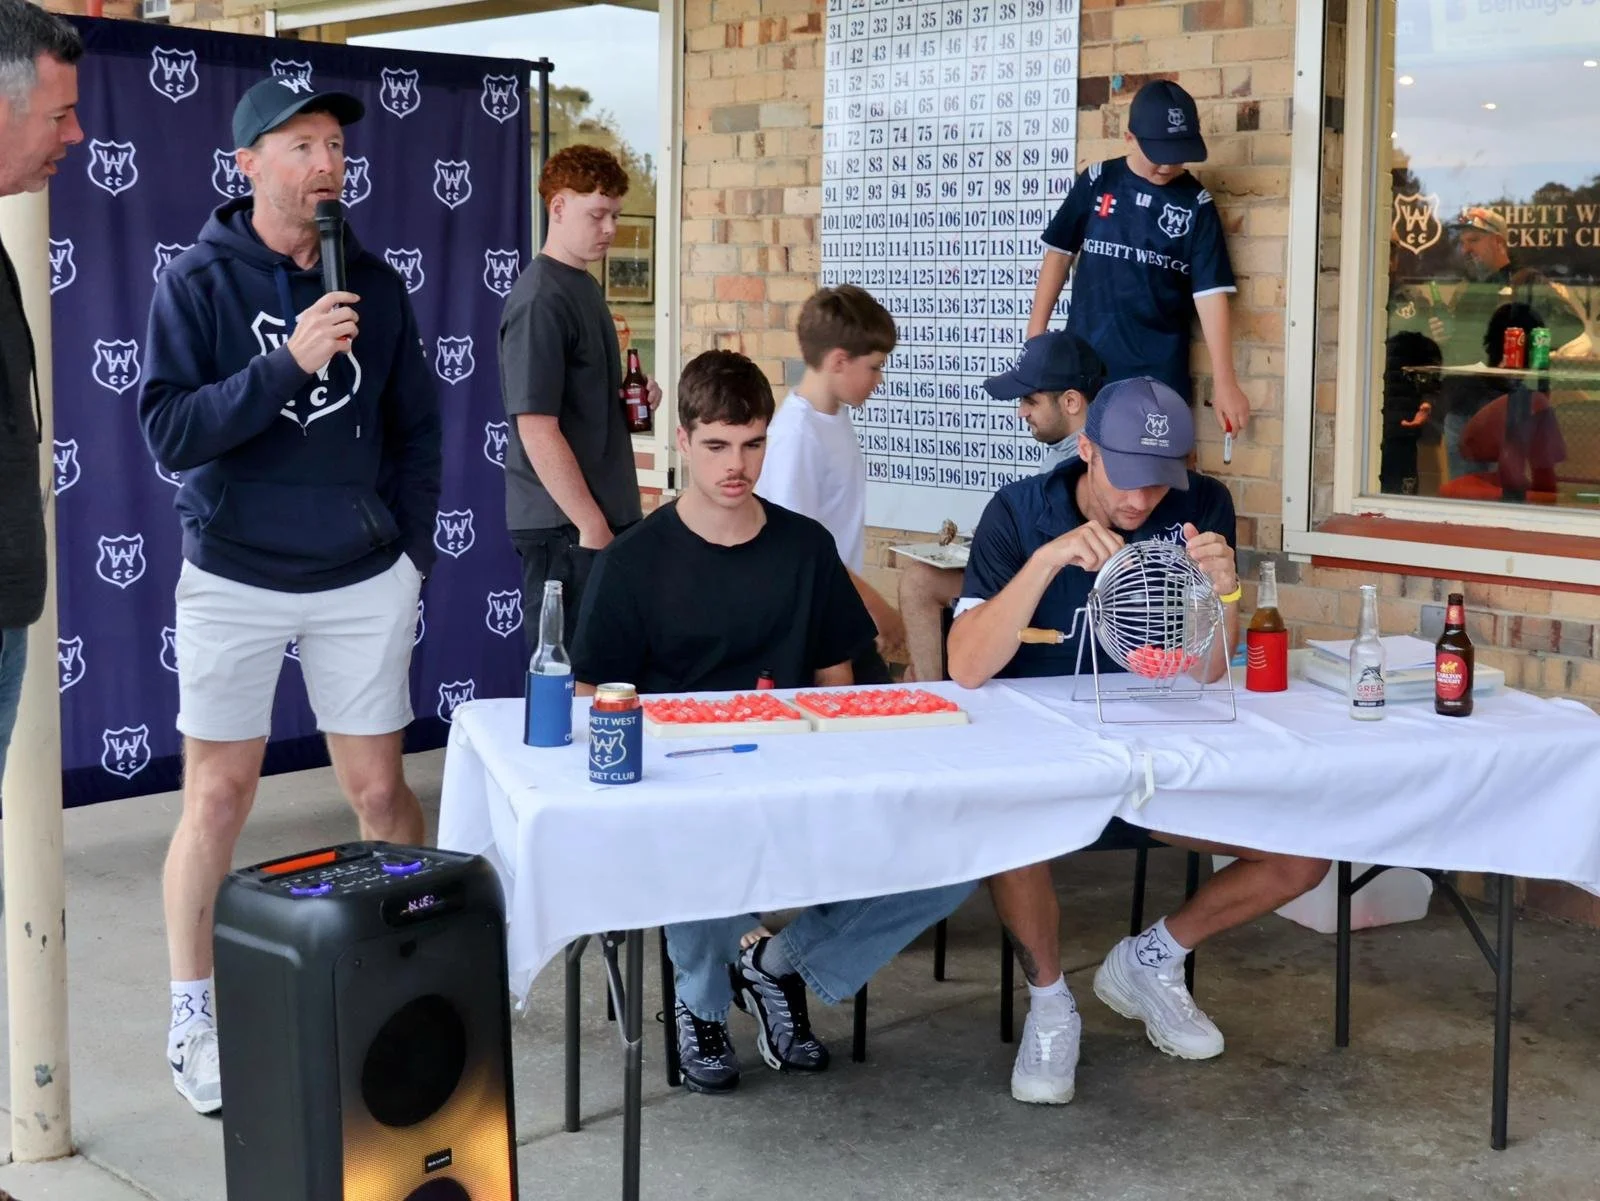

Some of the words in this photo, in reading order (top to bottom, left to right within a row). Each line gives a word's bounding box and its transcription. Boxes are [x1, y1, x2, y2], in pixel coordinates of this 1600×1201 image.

[830, 0, 842, 12] 21
[829, 24, 841, 38] 31
[851, 20, 864, 36] 32
[873, 17, 887, 34] 33
[896, 14, 912, 31] 34
[921, 13, 936, 28] 35
[947, 10, 962, 25] 36
[973, 7, 989, 23] 37
[1000, 3, 1016, 19] 38
[1028, 0, 1044, 17] 39
[1056, 0, 1073, 14] 40
[850, 48, 863, 64] 42
[872, 45, 886, 61] 43
[920, 40, 935, 56] 45
[1027, 29, 1043, 47] 49
[1054, 27, 1072, 44] 50
[849, 75, 862, 91] 52
[1025, 60, 1042, 77] 59
[1053, 57, 1071, 75] 60
[870, 103, 884, 118] 63
[997, 92, 1013, 109] 68
[1024, 90, 1041, 106] 69
[1053, 88, 1070, 104] 70
[870, 128, 884, 144] 73
[893, 127, 907, 143] 74
[917, 126, 933, 142] 75
[943, 124, 958, 140] 76
[1024, 119, 1040, 136] 79
[1052, 117, 1069, 134] 80
[869, 156, 882, 172] 83
[892, 155, 906, 171] 84
[917, 155, 932, 170] 85
[942, 153, 957, 169] 86
[968, 152, 984, 168] 87
[995, 150, 1012, 167] 88
[1023, 149, 1039, 165] 89
[1051, 148, 1069, 163] 90
[825, 187, 837, 202] 91
[846, 185, 859, 201] 92
[868, 184, 882, 200] 93
[892, 184, 906, 199] 94
[917, 183, 931, 198] 95
[942, 182, 957, 197] 96
[967, 181, 983, 196] 97
[995, 180, 1011, 195] 98
[1022, 178, 1039, 195] 99
[1047, 178, 1073, 195] 100
[822, 215, 840, 230] 101
[843, 214, 862, 229] 102
[866, 213, 885, 229] 103
[890, 213, 909, 228] 104
[915, 212, 934, 228] 105
[939, 212, 960, 227] 106
[965, 211, 987, 226] 107
[991, 210, 1014, 226] 108
[1019, 209, 1042, 225] 109
[1490, 204, 1568, 224] HETT
[1576, 204, 1600, 224] W
[822, 243, 839, 257] 111
[843, 242, 862, 257] 112
[866, 242, 885, 257] 113
[890, 241, 909, 256] 114
[914, 241, 934, 256] 115
[939, 241, 960, 256] 116
[965, 240, 986, 256] 117
[991, 240, 1014, 255] 118
[1018, 238, 1042, 256] 119
[1136, 248, 1171, 268] WEST
[822, 270, 840, 285] 121
[842, 269, 862, 285] 122
[866, 269, 885, 284] 123
[889, 269, 909, 284] 124
[914, 269, 934, 285] 125
[939, 269, 960, 285] 126
[964, 269, 986, 285] 127
[991, 269, 1014, 285] 128
[1018, 269, 1042, 285] 129
[889, 297, 909, 313] 134
[913, 298, 934, 313] 135
[938, 298, 960, 313] 136
[964, 298, 986, 314] 137
[990, 298, 1013, 315] 138
[1018, 299, 1033, 315] 13
[913, 326, 934, 341] 145
[938, 326, 960, 342] 146
[964, 327, 986, 343] 147
[990, 328, 1013, 343] 148
[889, 353, 909, 369] 154
[913, 355, 934, 369] 155
[938, 355, 960, 371] 156
[963, 356, 986, 372] 157
[990, 356, 1013, 373] 158
[889, 381, 909, 397] 164
[913, 382, 934, 398] 165
[938, 383, 960, 399] 166
[963, 384, 987, 400] 167
[867, 408, 887, 423] 173
[890, 409, 910, 424] 174
[914, 410, 935, 426] 175
[938, 412, 960, 427] 176
[964, 413, 986, 429] 177
[990, 415, 1013, 431] 178
[867, 435, 887, 450] 183
[890, 437, 910, 452] 184
[914, 439, 935, 454] 185
[938, 440, 961, 456] 186
[963, 442, 986, 458] 187
[990, 444, 1013, 460] 188
[1017, 445, 1041, 461] 189
[867, 461, 886, 478] 193
[890, 464, 910, 480] 194
[914, 466, 935, 482] 195
[939, 468, 961, 484] 196
[964, 470, 986, 486] 197
[990, 470, 1014, 488] 198
[611, 717, 636, 725] WEST
[610, 771, 635, 780] CLUB
